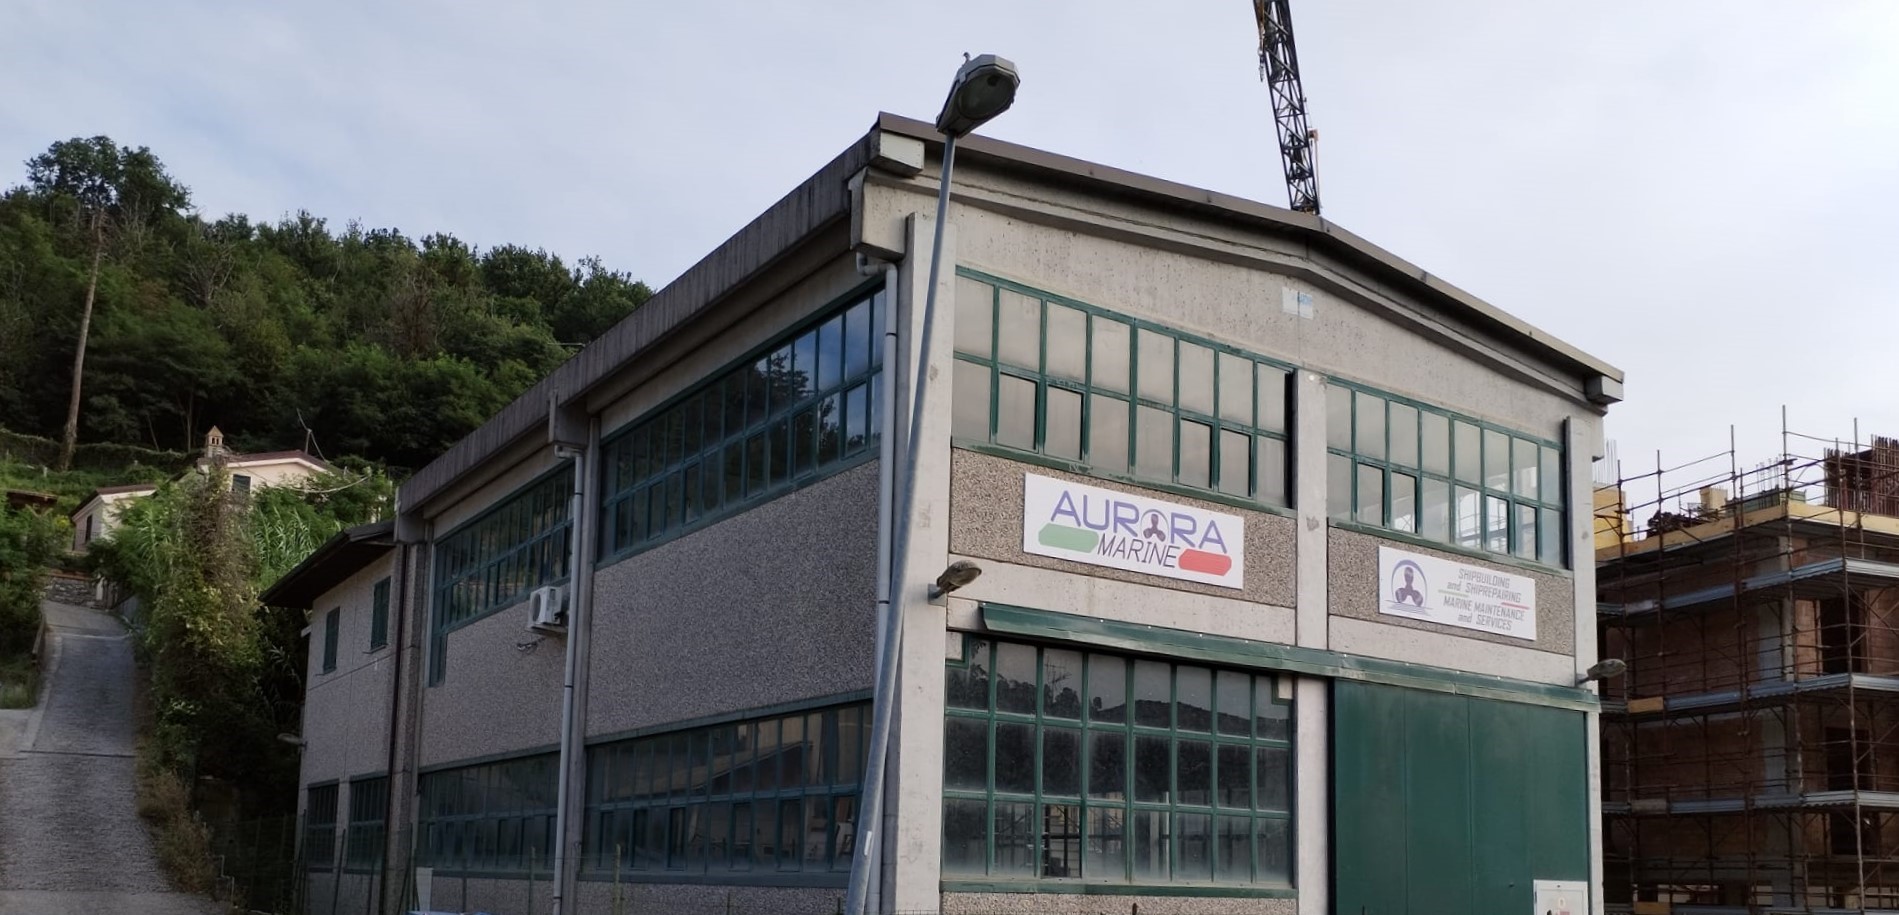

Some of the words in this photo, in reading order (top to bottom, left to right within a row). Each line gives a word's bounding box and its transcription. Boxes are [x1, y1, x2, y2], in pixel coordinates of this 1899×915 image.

[1051, 490, 1227, 554] AURORA
[1097, 533, 1180, 568] MARINE
[1458, 568, 1510, 588] SHIPBUILDING
[1447, 581, 1461, 591] and
[1465, 583, 1521, 603] SHIPREPAIRING
[1443, 596, 1472, 611] MARINE
[1474, 602, 1525, 621] MAINTENANCE
[1458, 613, 1472, 623] and
[1476, 614, 1512, 631] SERVICES
